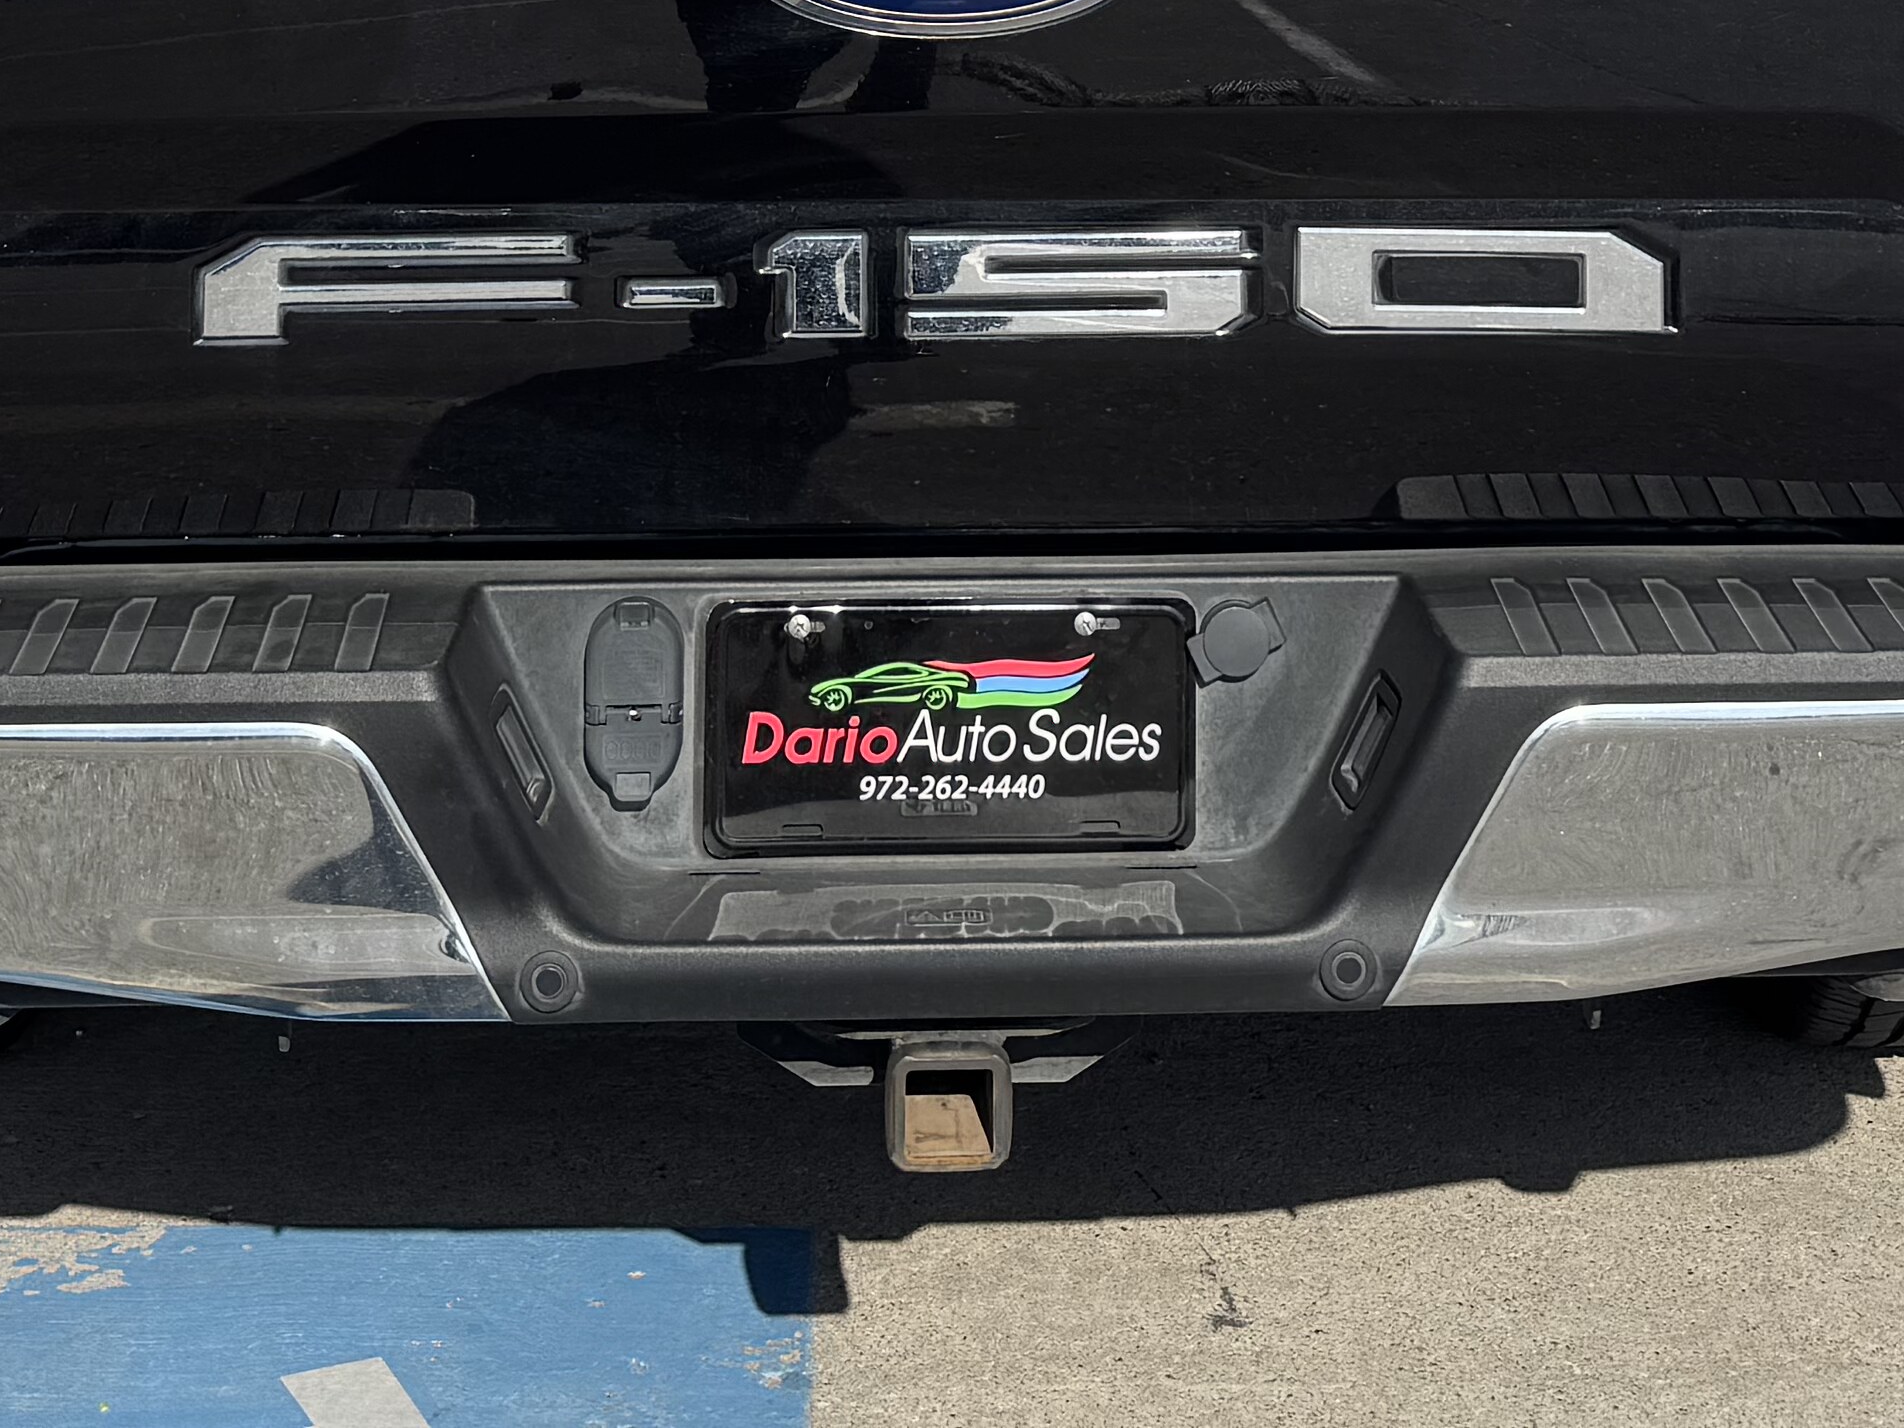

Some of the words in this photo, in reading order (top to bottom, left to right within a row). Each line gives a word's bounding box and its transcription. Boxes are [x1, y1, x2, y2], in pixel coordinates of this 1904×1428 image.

[192, 228, 1679, 343] F-150
[741, 711, 898, 765] Dario
[897, 708, 1017, 764] Auto
[1023, 708, 1162, 764] Sales
[858, 774, 1046, 801] 972-262-4440
